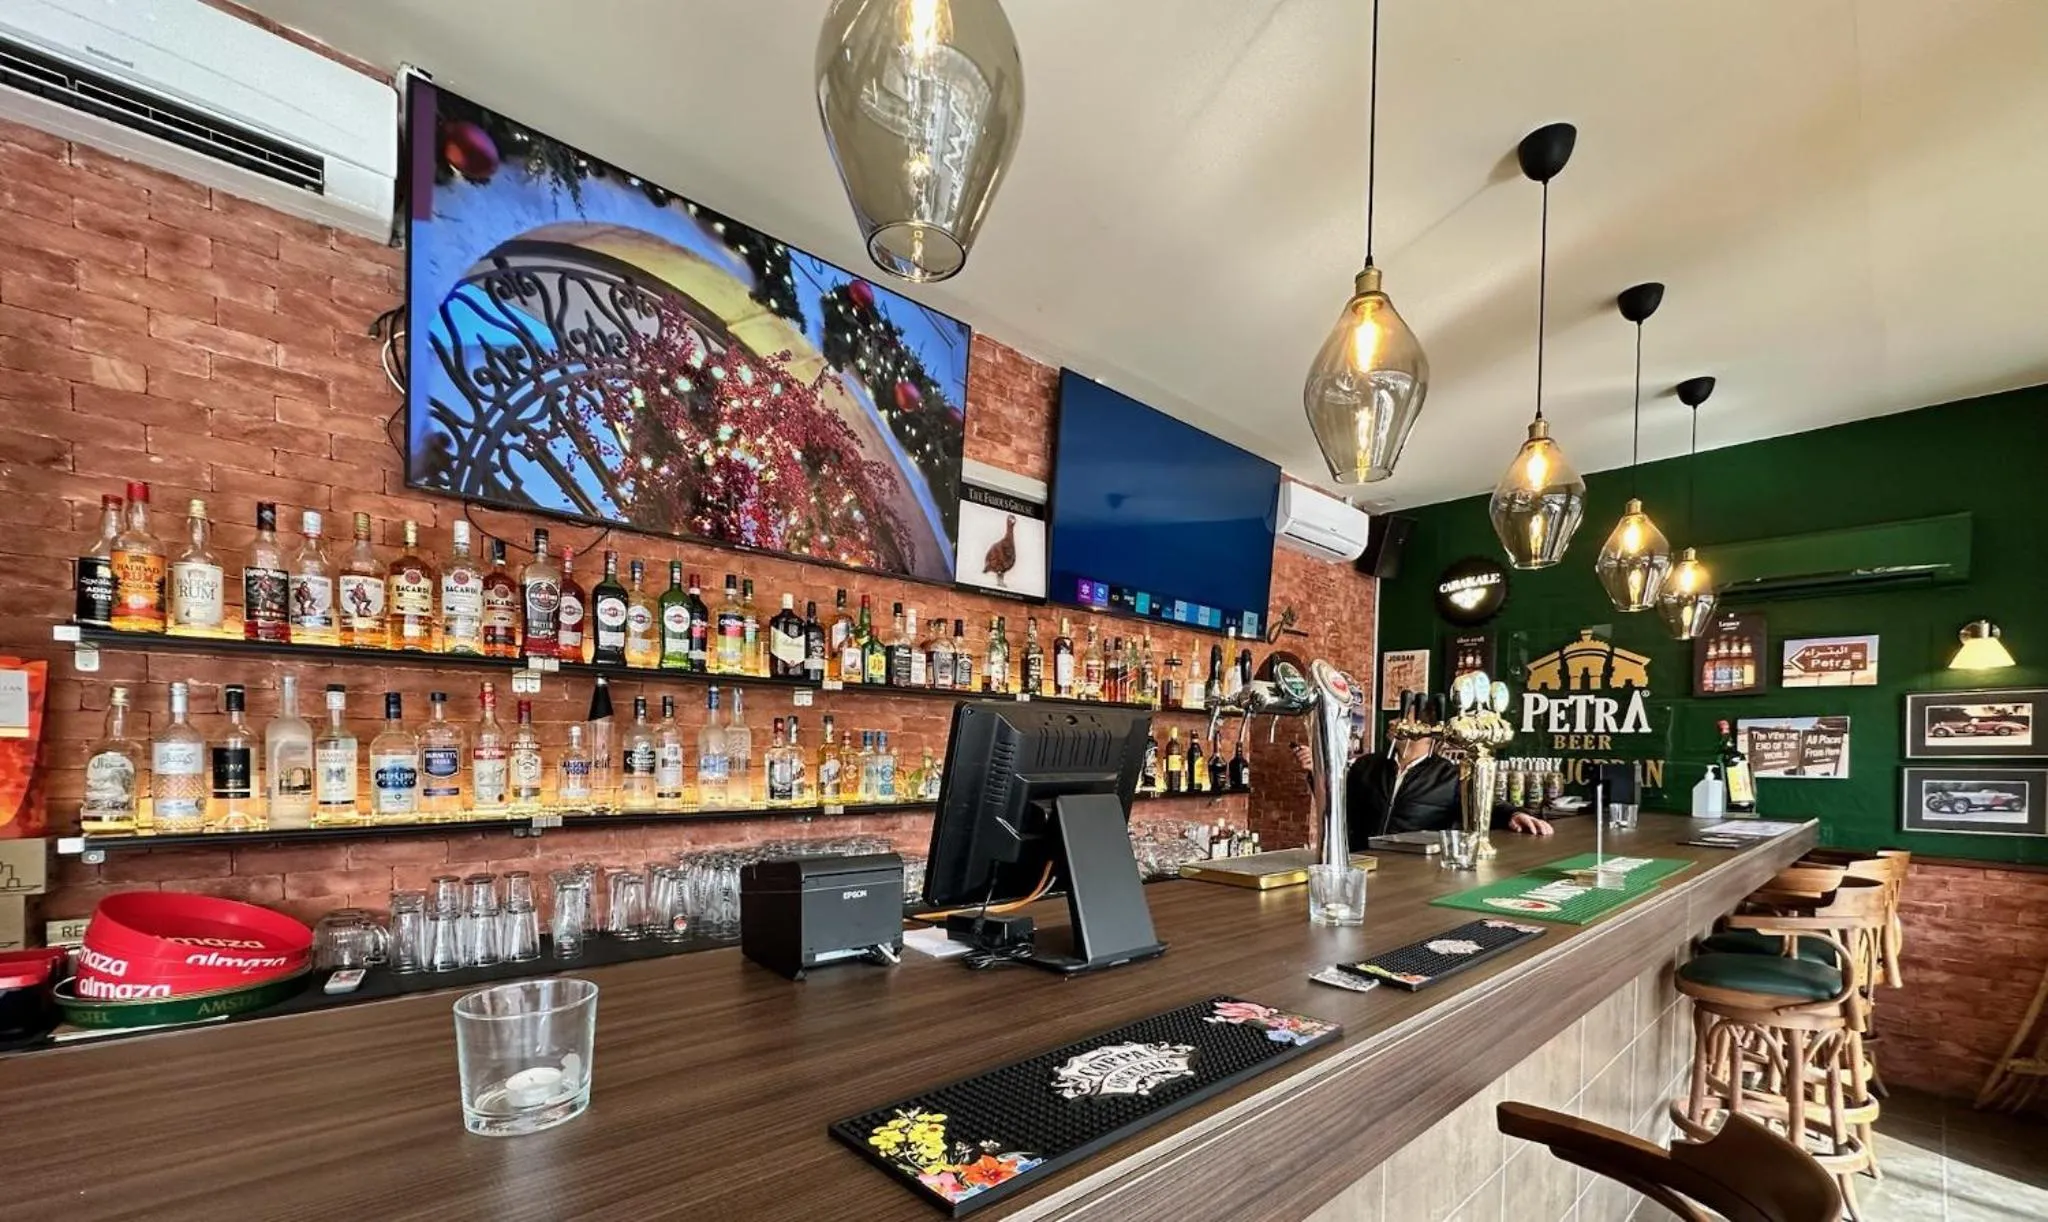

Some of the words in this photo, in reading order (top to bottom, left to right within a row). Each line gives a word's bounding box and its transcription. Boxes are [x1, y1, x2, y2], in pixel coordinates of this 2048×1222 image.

[968, 488, 984, 501] THE
[180, 585, 215, 600] RUM
[395, 585, 429, 594] BACARDI
[445, 585, 477, 594] BACARDI
[1811, 658, 1851, 669] Petra
[1521, 689, 1652, 733] PETRA
[1554, 734, 1612, 750] BEER
[843, 890, 867, 900] EPSON
[61, 925, 84, 938] RE
[185, 951, 288, 974] almaza
[79, 975, 171, 999] almaza
[1078, 1050, 1147, 1077] COPPA
